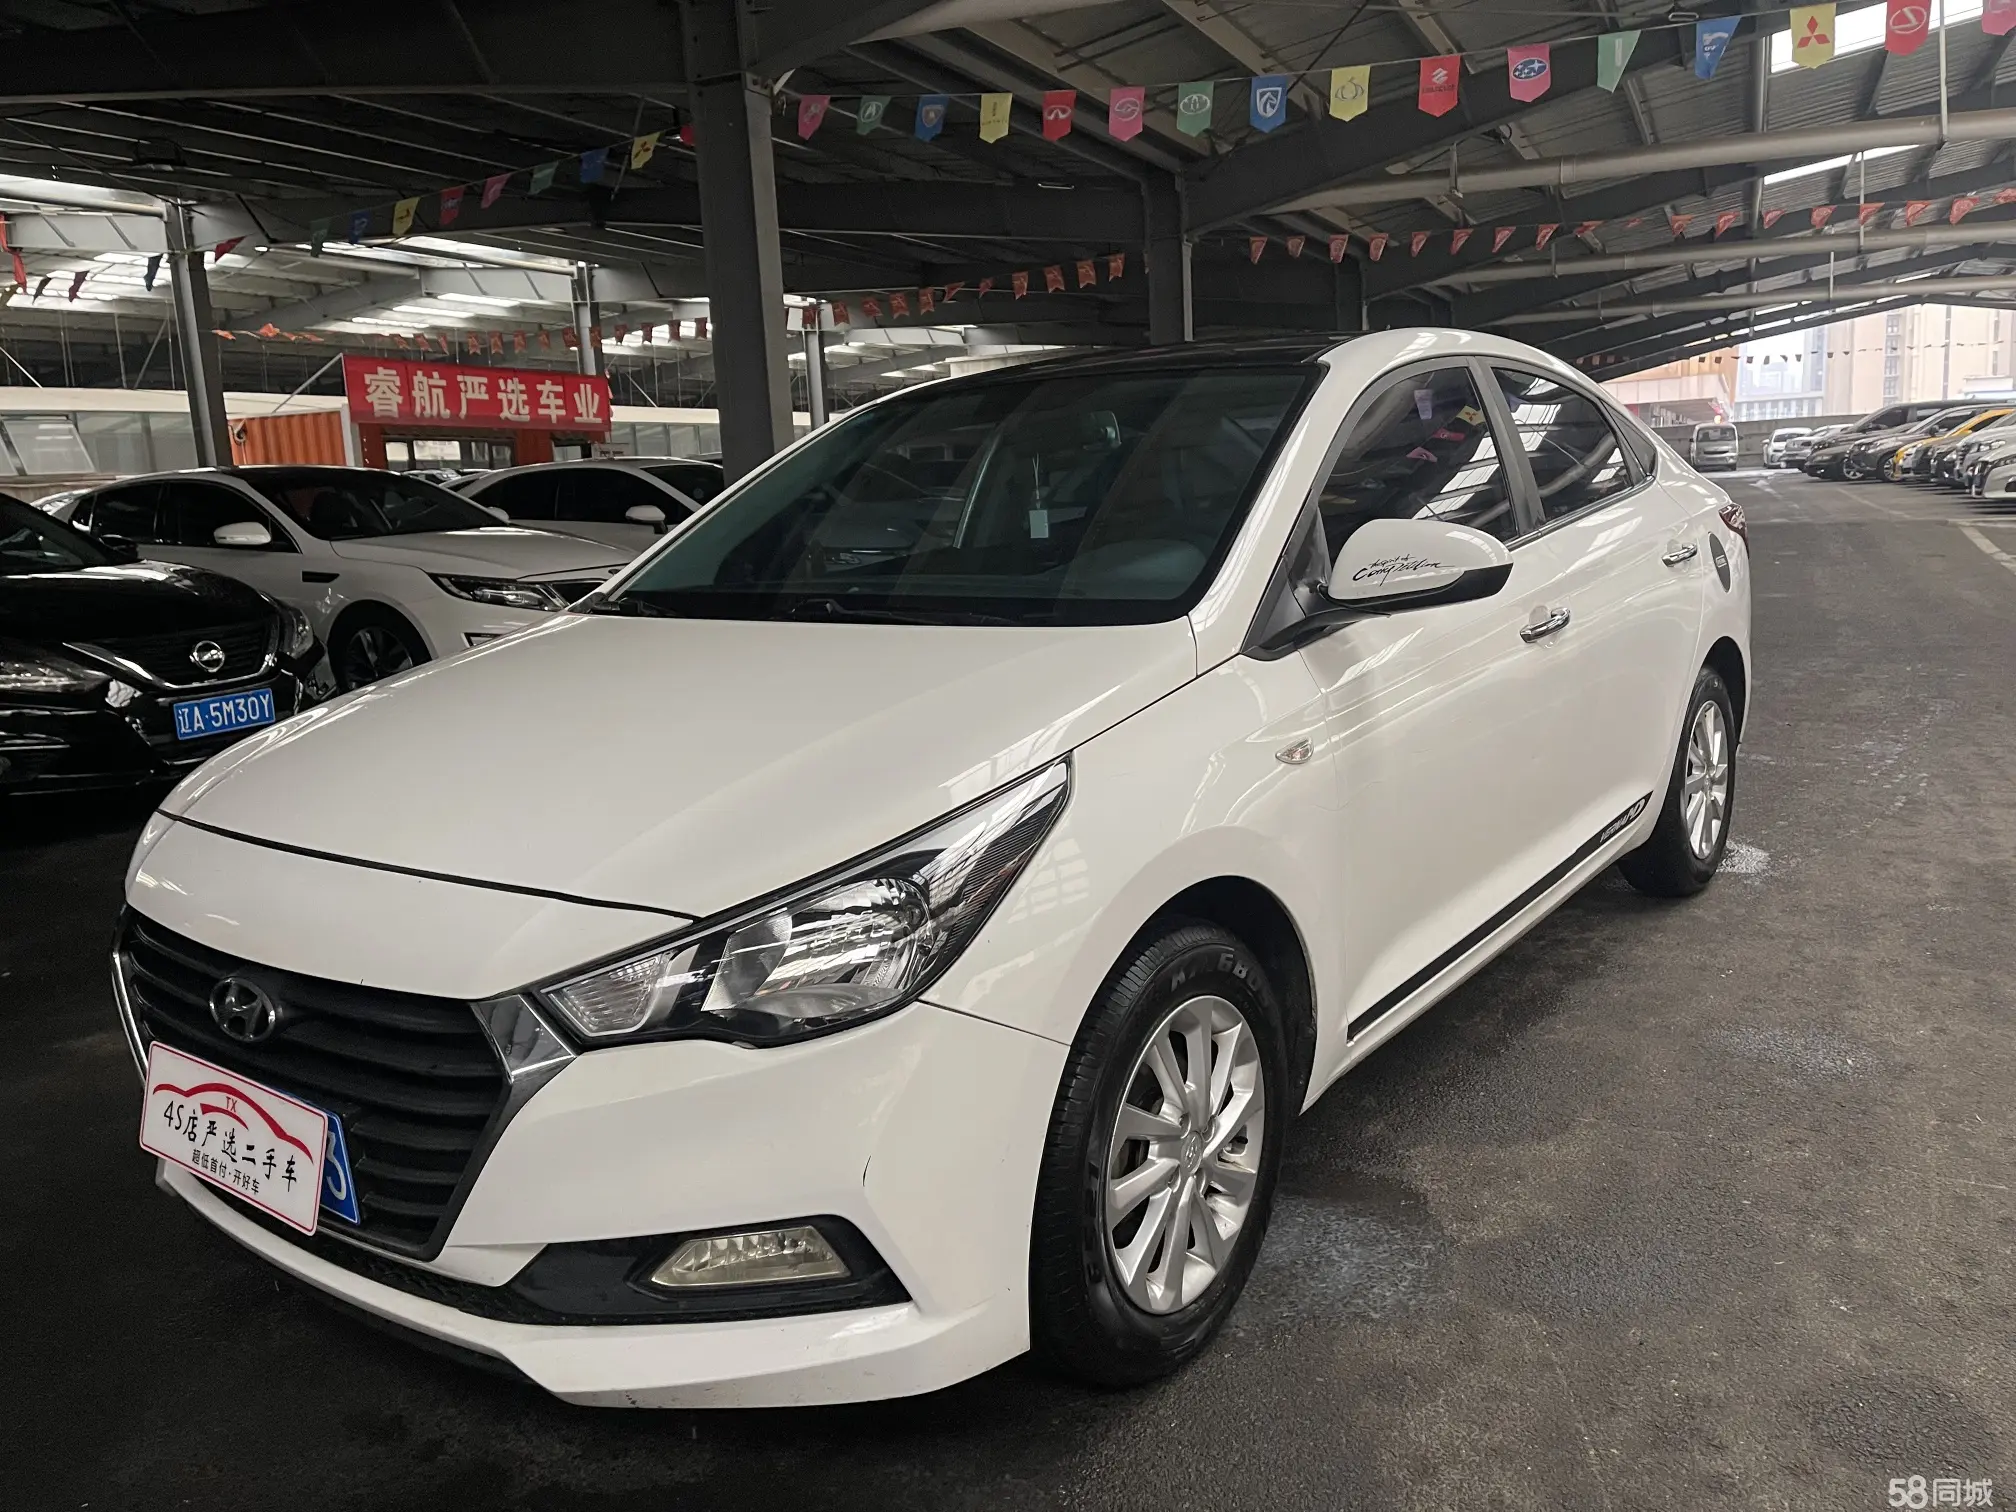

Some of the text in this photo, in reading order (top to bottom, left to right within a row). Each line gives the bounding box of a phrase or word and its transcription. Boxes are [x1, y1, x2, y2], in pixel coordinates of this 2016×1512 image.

[363, 366, 602, 425] 睿航严选车业
[163, 1100, 297, 1192] 4S店严选二手车
